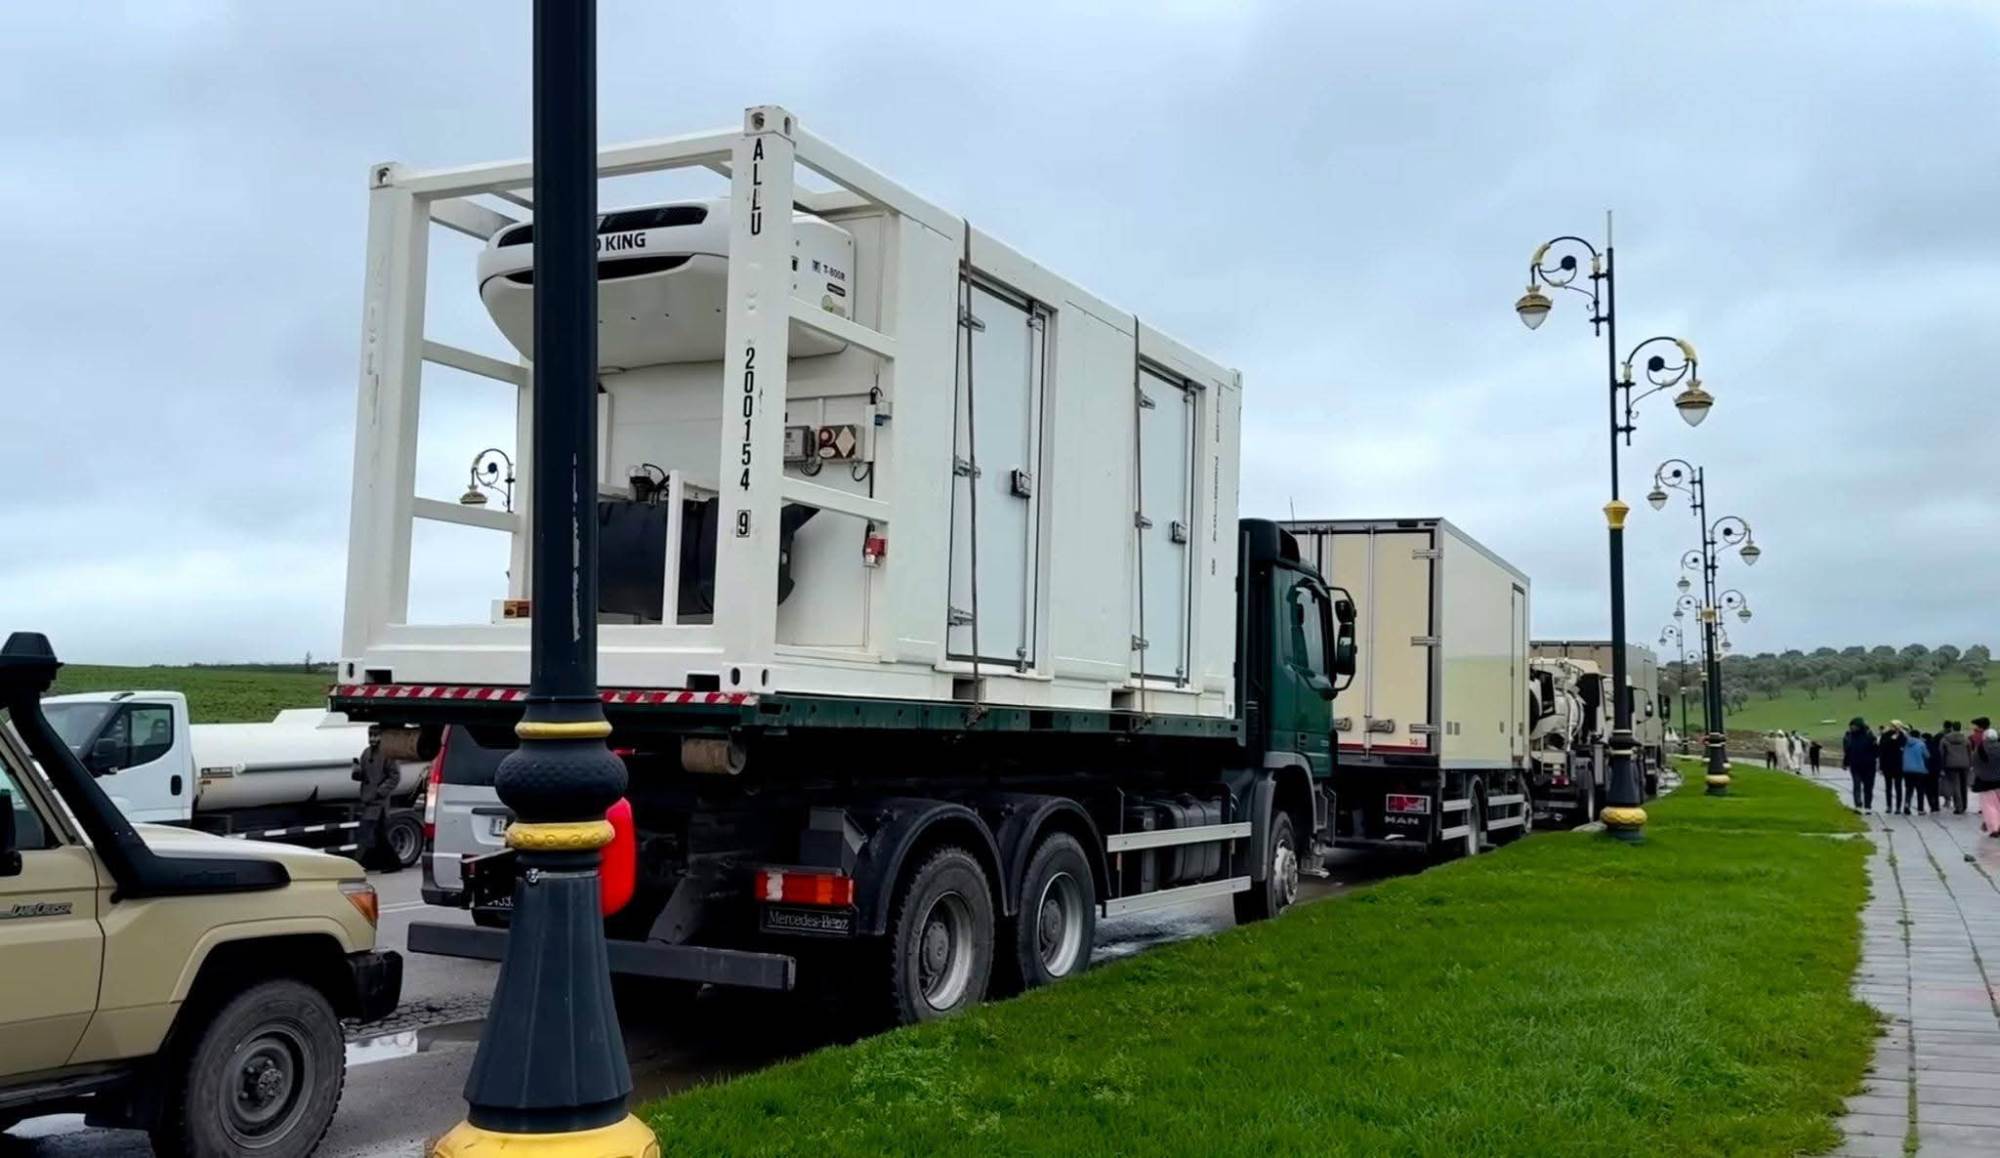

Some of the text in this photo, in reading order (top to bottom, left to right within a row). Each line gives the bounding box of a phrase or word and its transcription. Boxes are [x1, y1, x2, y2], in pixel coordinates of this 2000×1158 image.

[605, 232, 646, 252] KING
[738, 137, 764, 536] ALLU 200154 9
[1384, 816, 1419, 825] MAN
[767, 910, 849, 930] Mercedes-Benz
